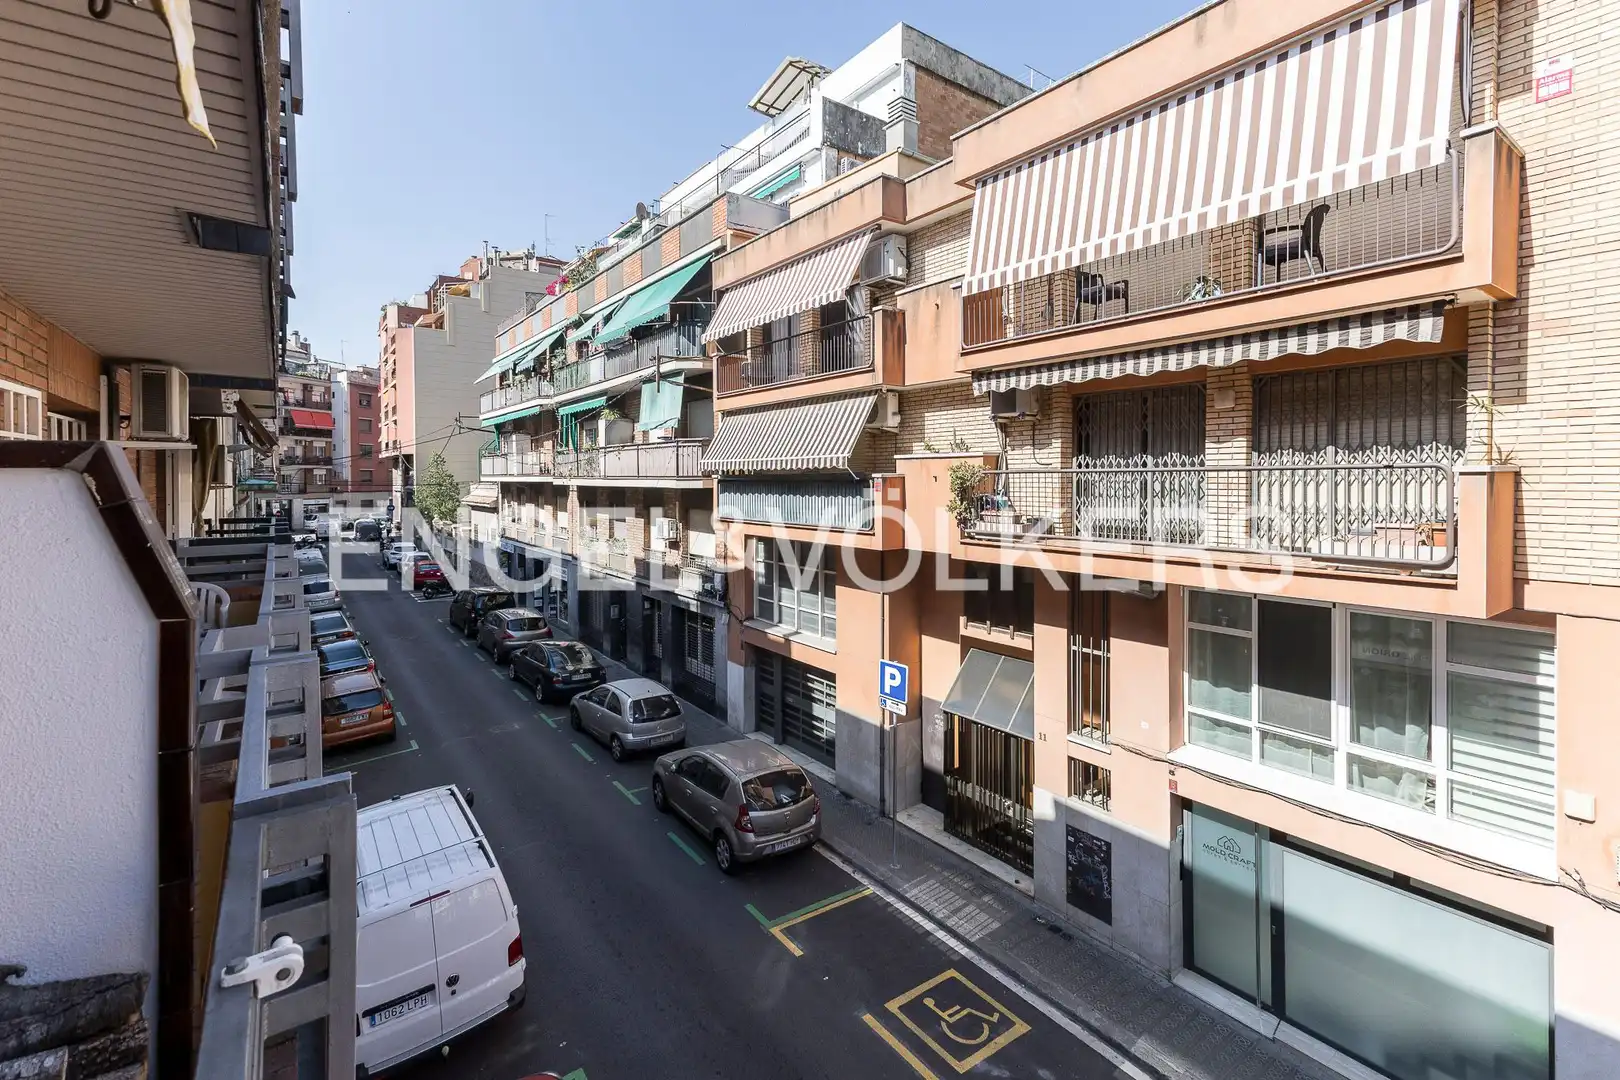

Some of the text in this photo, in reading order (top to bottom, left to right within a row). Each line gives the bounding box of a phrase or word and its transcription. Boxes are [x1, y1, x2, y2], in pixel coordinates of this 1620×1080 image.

[885, 665, 902, 694] P
[1039, 732, 1047, 742] 11
[1202, 843, 1226, 856] MOLD
[1228, 853, 1256, 867] CRAFT
[378, 995, 427, 1021] 1062 LPH
